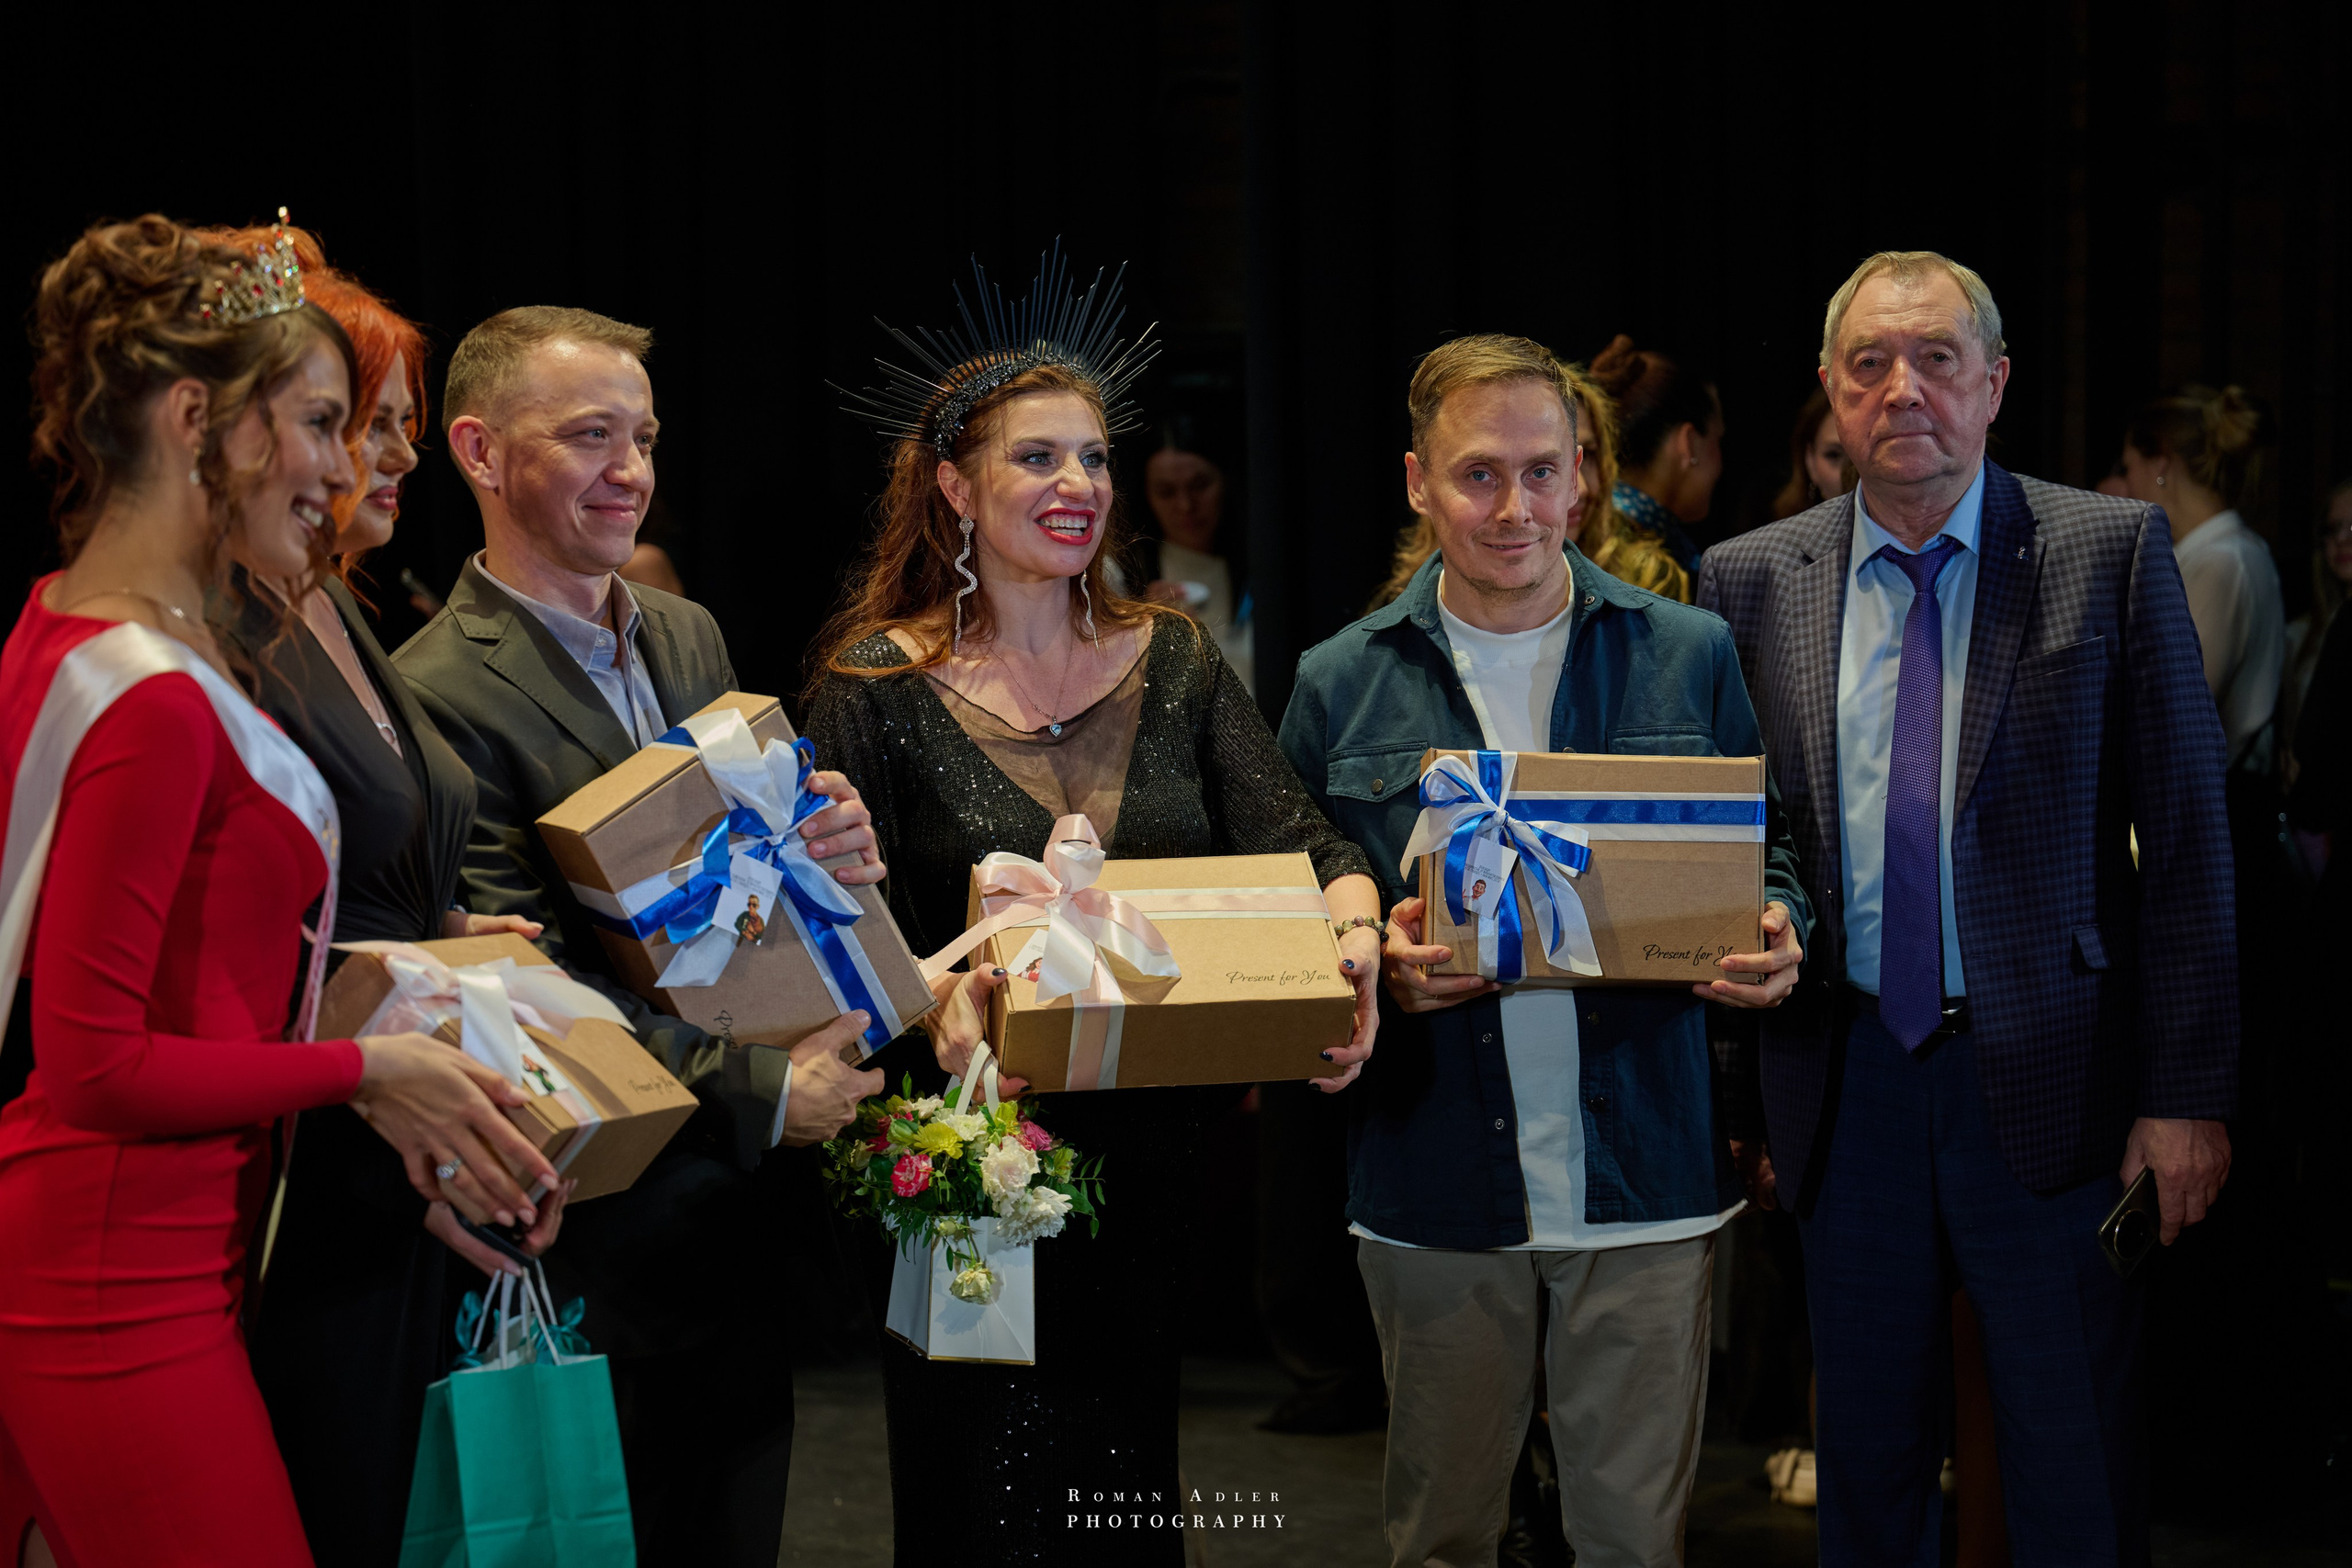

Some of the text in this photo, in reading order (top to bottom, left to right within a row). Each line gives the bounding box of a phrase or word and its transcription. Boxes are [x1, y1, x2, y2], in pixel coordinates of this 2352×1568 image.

[1643, 944, 1691, 962] Present
[1692, 945, 1713, 966] for
[1226, 970, 1331, 986] Present for You
